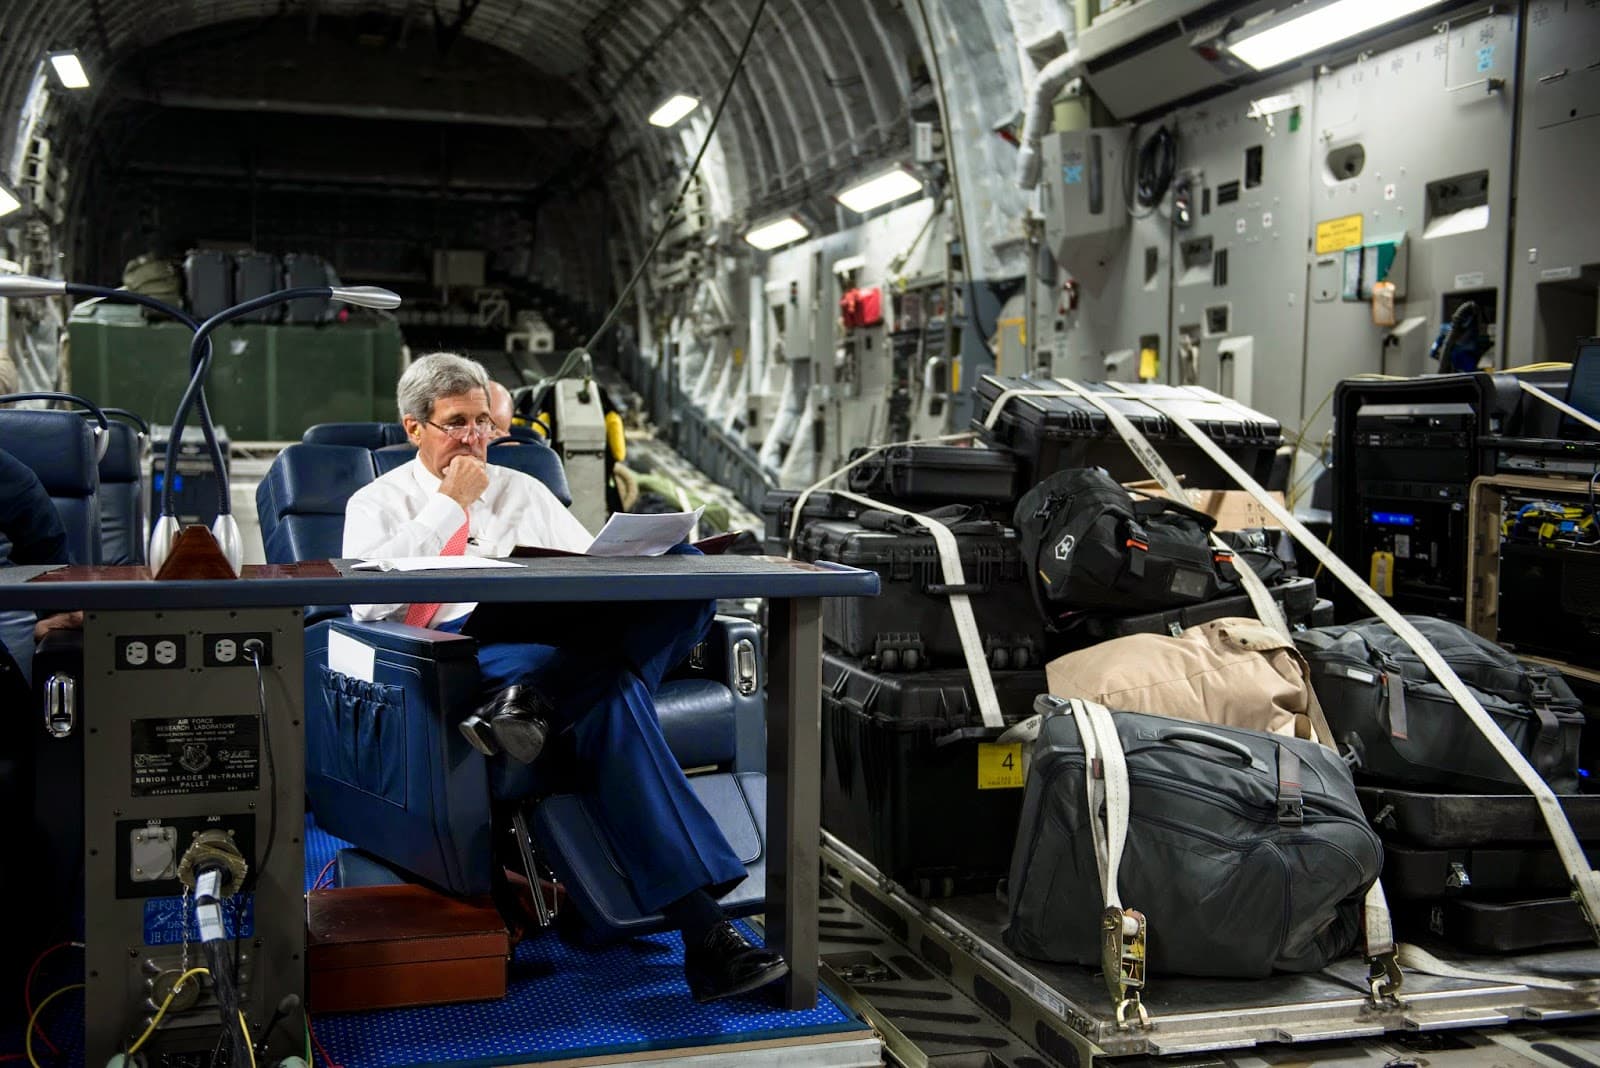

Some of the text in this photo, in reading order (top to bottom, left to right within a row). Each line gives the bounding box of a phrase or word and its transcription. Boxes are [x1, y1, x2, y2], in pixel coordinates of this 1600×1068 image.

[194, 723, 235, 731] LABORATORY
[1002, 752, 1014, 771] 4
[135, 772, 254, 784] SENIOR LEADER IN-TRANSIT
[180, 780, 209, 788] PALLET
